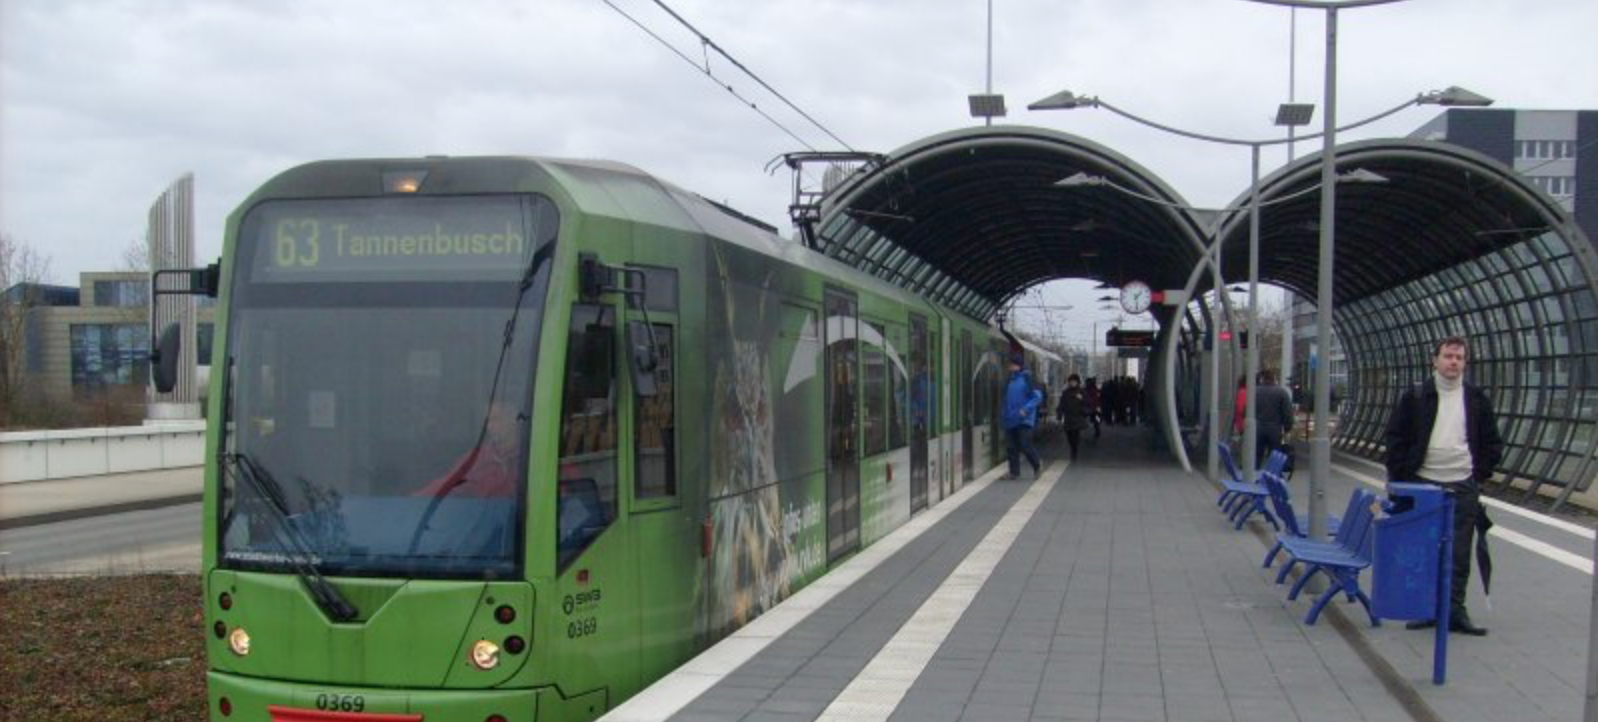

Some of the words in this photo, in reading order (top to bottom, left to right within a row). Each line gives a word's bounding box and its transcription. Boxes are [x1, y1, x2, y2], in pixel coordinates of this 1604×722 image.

[275, 217, 319, 267] 63
[332, 222, 523, 257] Tannenbusch
[568, 616, 597, 639] 0369
[317, 694, 365, 713] 0369
